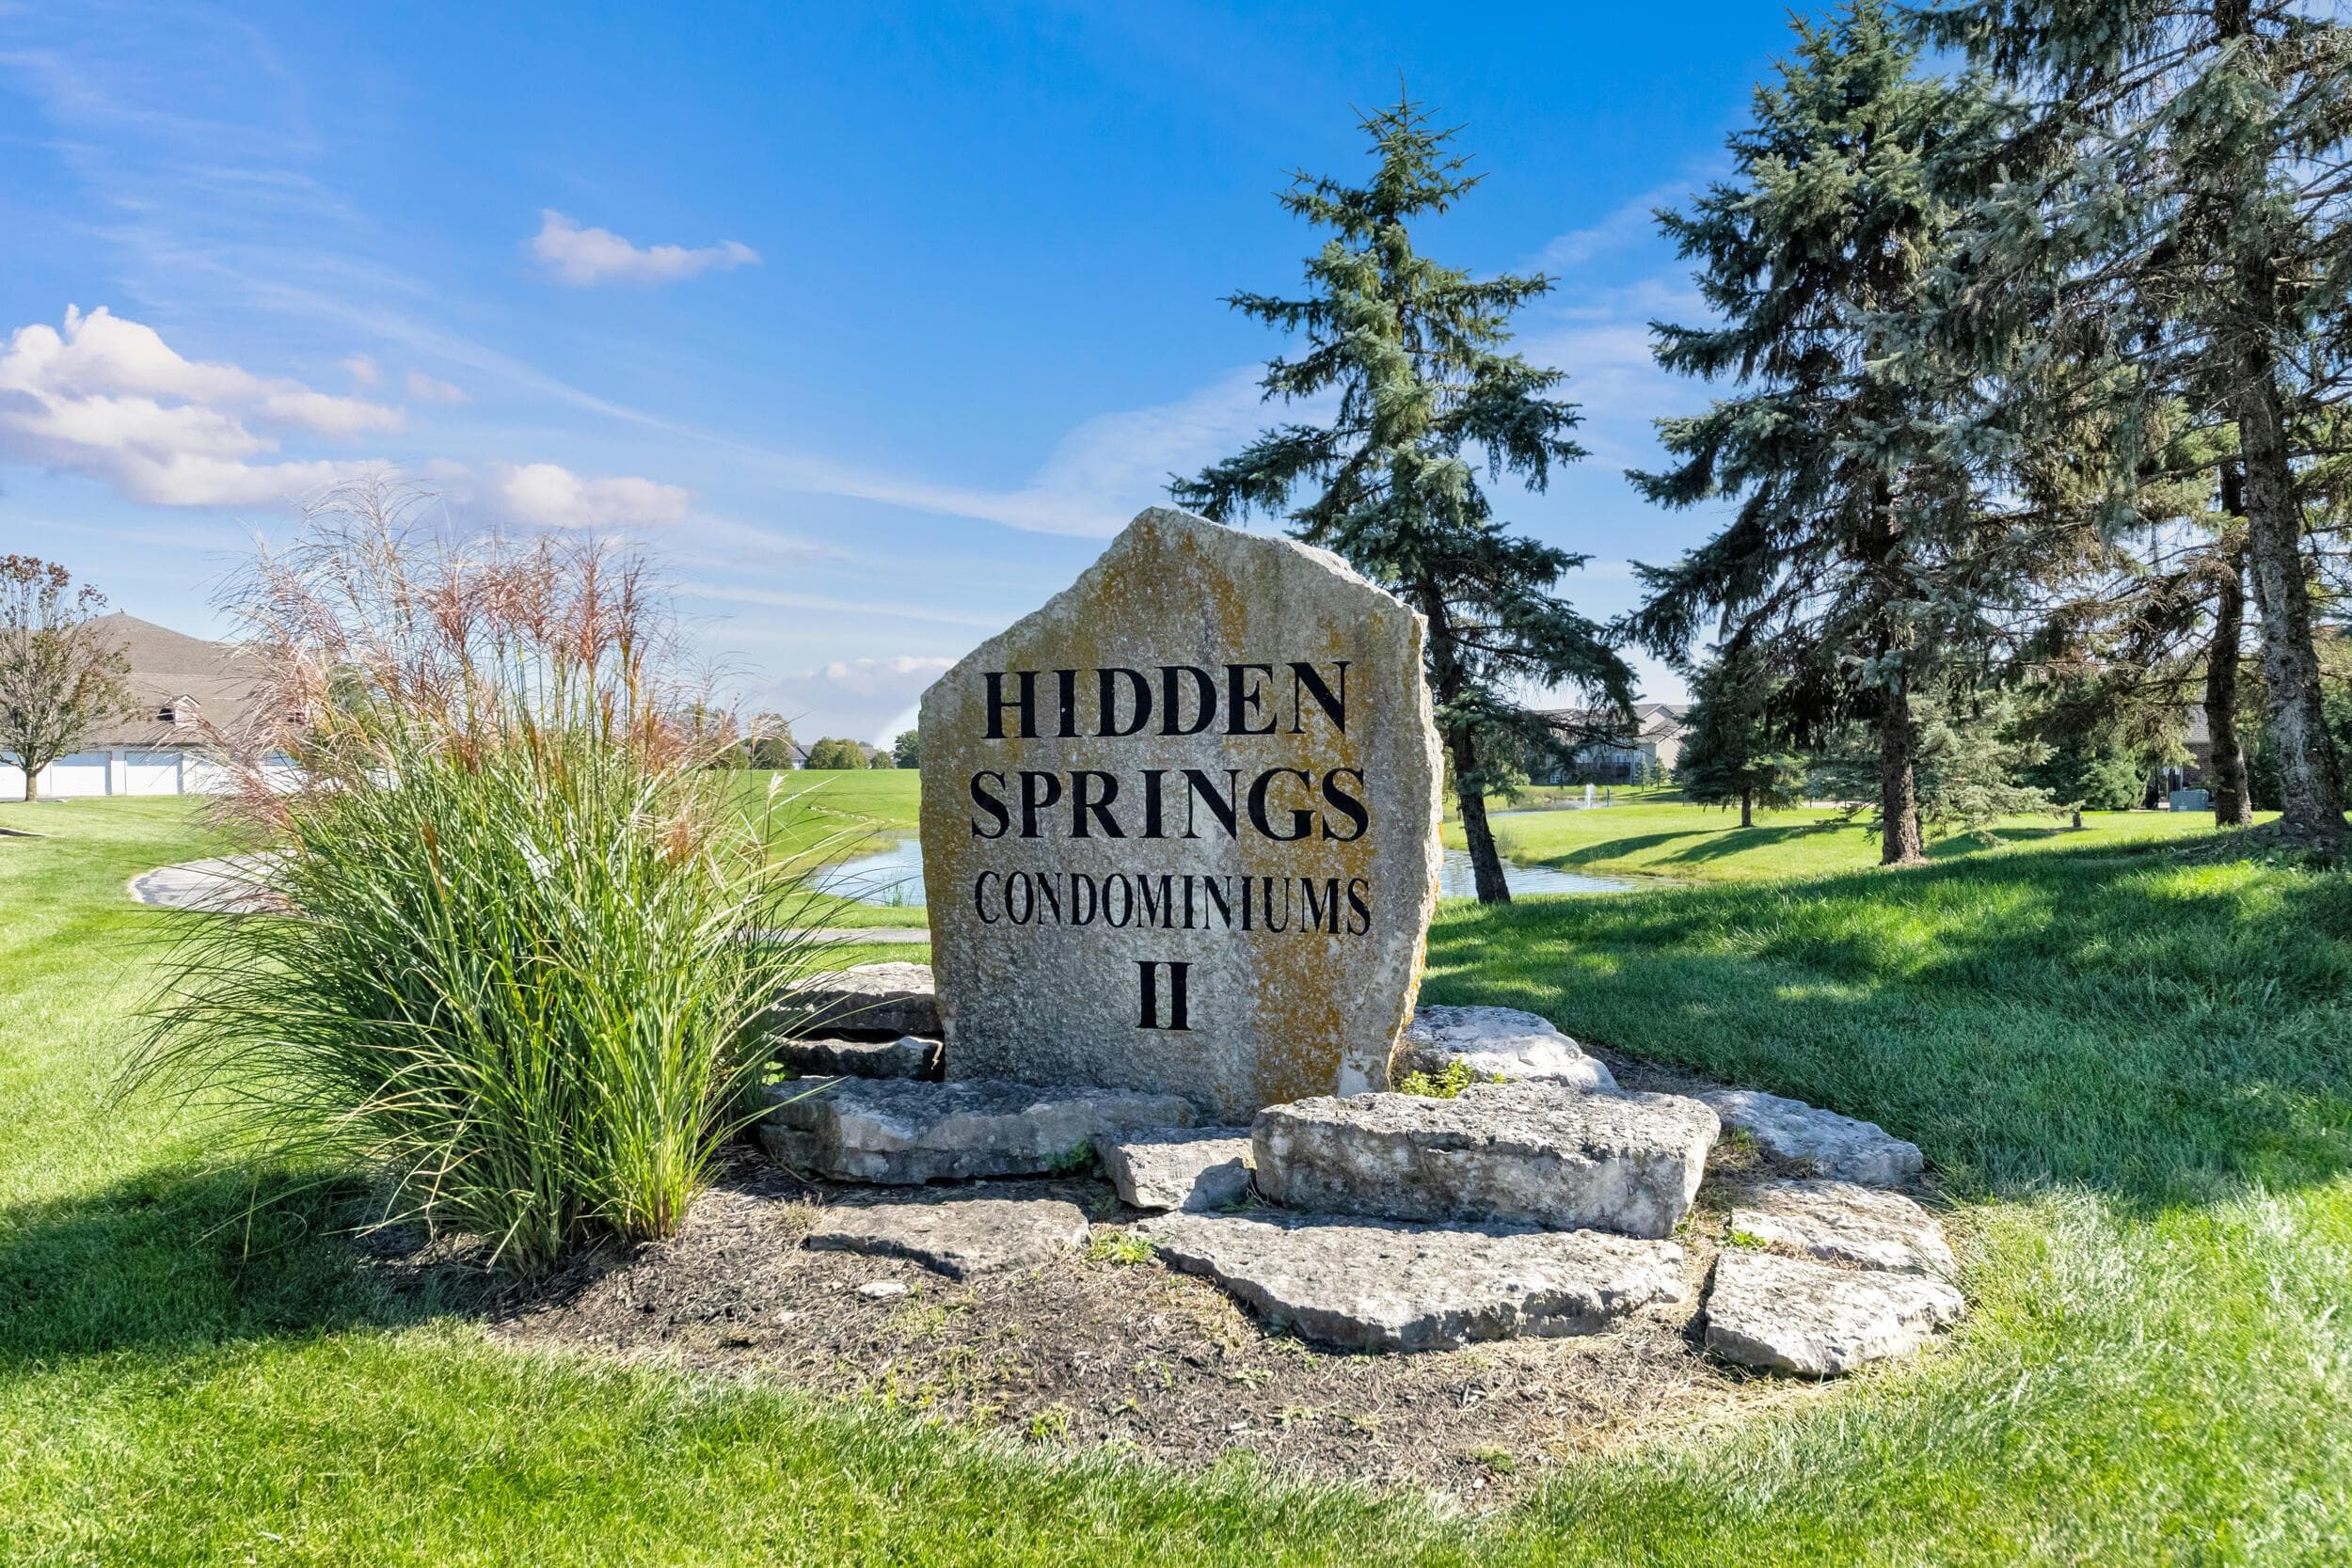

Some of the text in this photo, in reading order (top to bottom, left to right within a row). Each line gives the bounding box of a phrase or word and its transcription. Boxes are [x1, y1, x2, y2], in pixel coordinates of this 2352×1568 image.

[980, 660, 1352, 739] HIDDEN
[971, 767, 1369, 842] SPRINGS
[974, 870, 1371, 936] CONDOMINIUMS
[1133, 960, 1194, 1031] II
